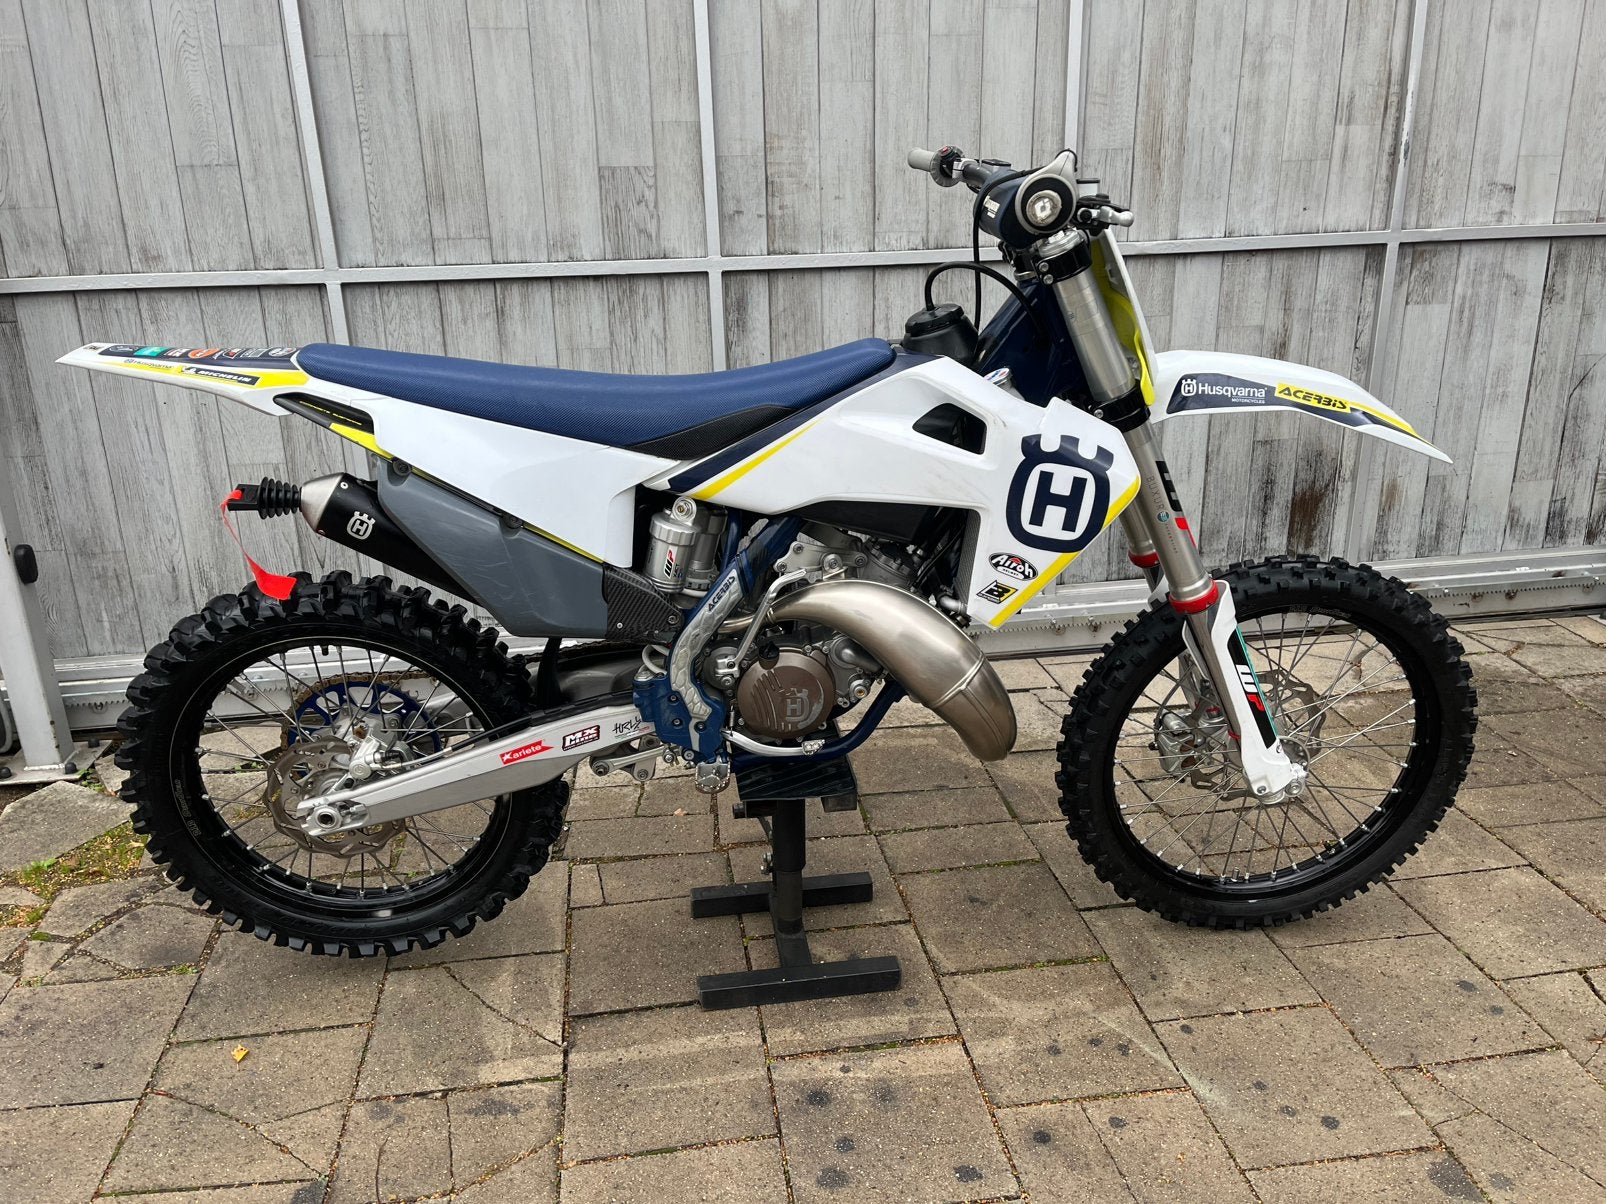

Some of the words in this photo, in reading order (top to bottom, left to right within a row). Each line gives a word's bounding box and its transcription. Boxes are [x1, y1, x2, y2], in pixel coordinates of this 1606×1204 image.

[198, 370, 252, 382] MICHELIN
[1198, 382, 1266, 398] Husqvarna
[991, 554, 1034, 578] Airoh
